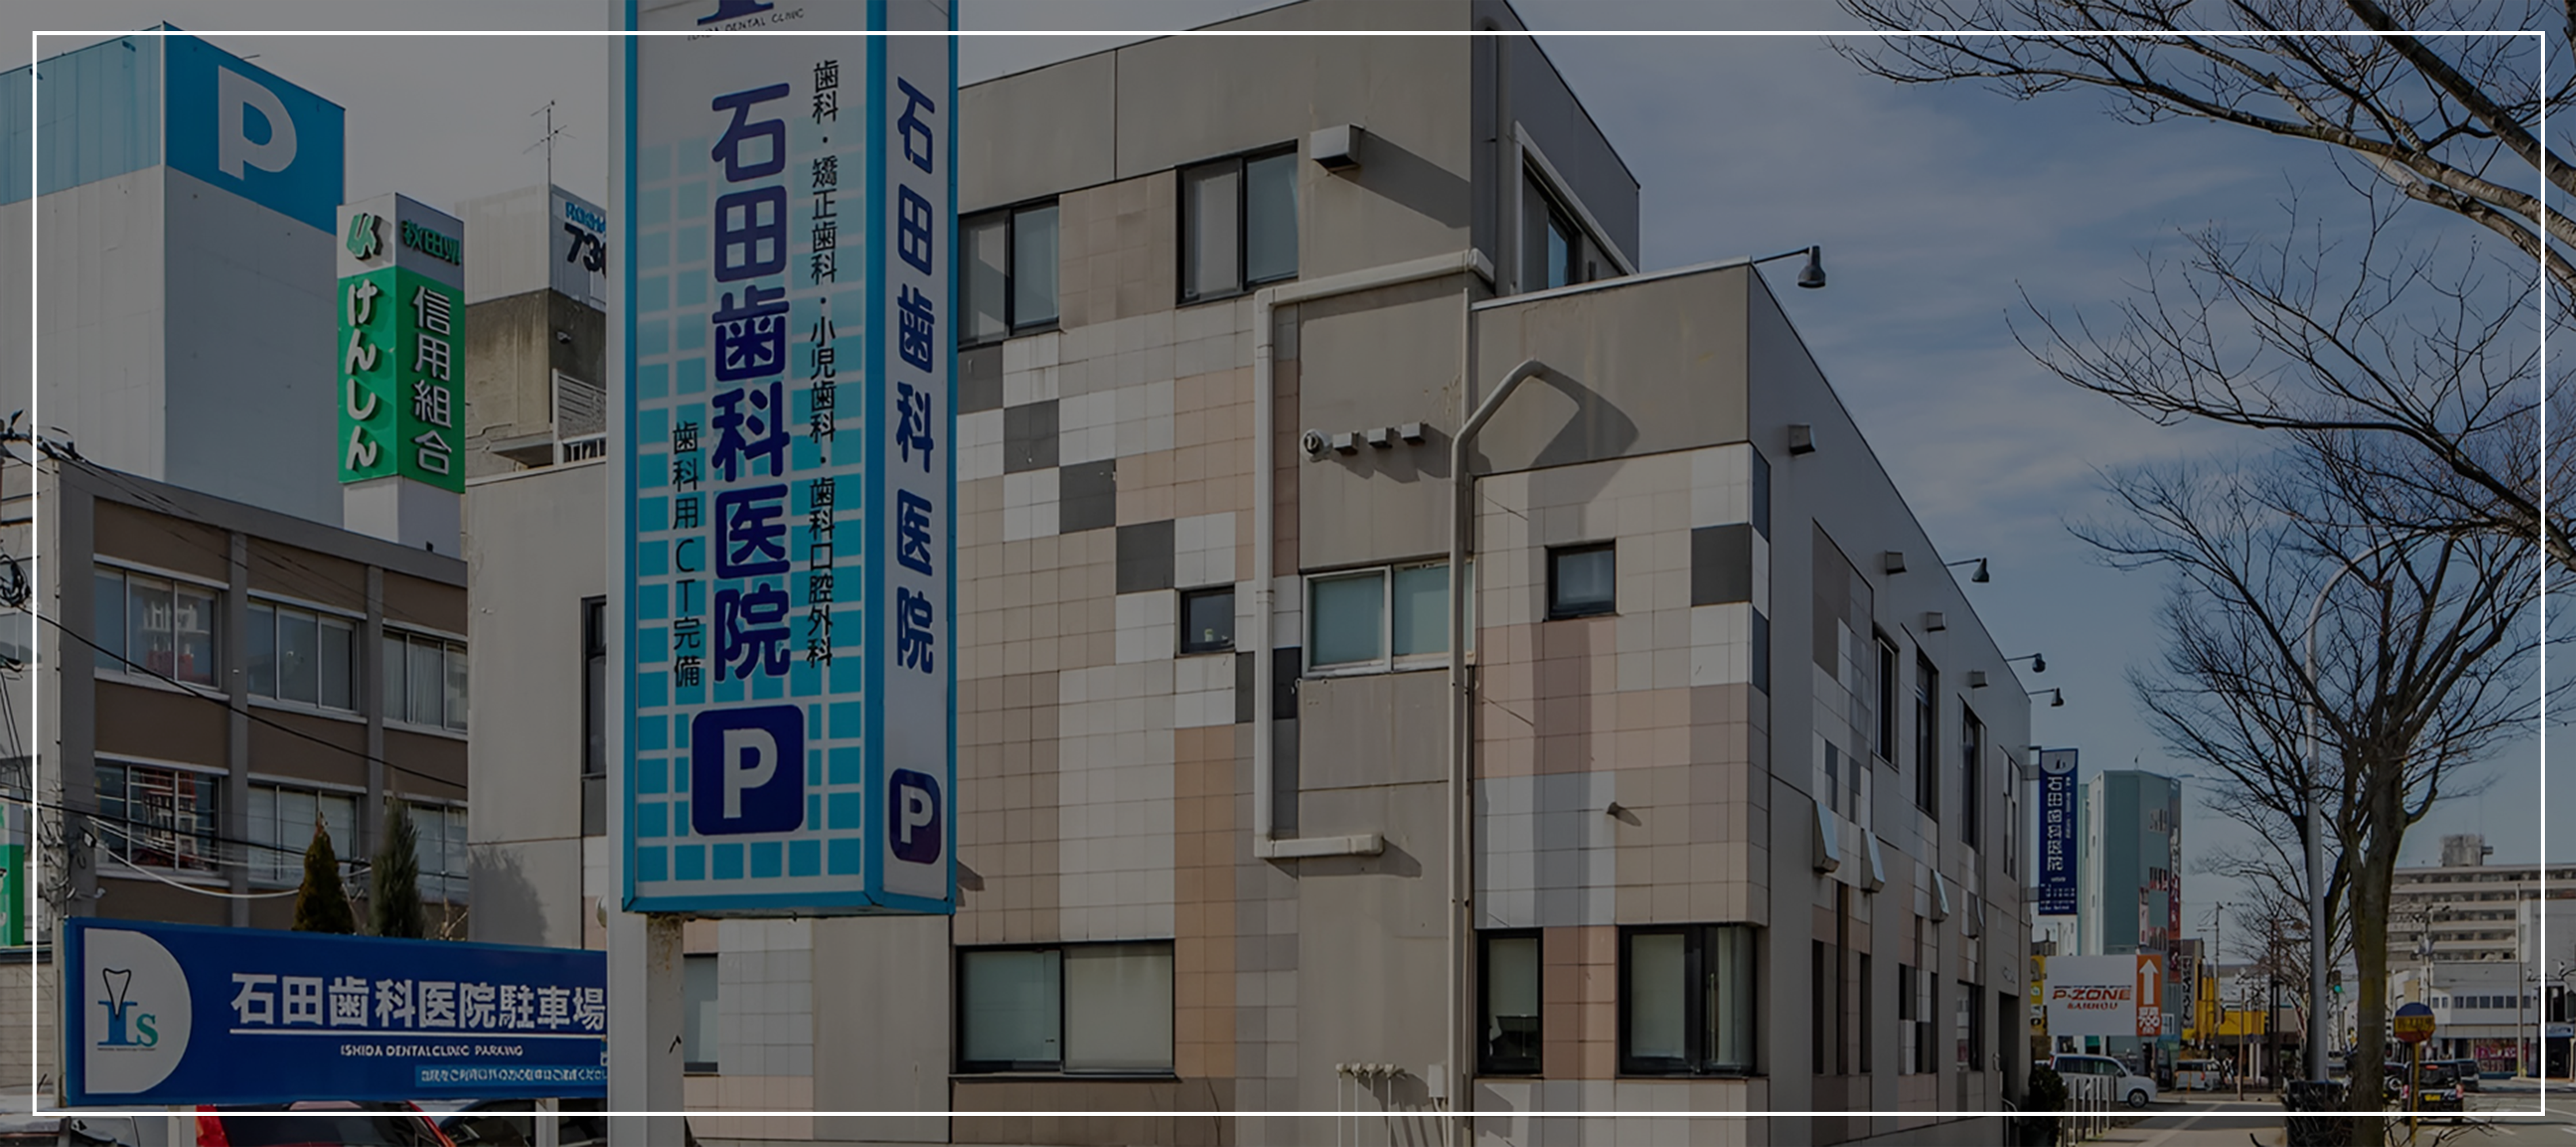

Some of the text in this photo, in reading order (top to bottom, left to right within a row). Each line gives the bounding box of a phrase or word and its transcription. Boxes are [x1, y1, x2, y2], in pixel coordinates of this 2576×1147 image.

[218, 65, 298, 181] P
[564, 222, 606, 278] 73
[344, 279, 380, 473] けんしん
[411, 285, 452, 476] 信用組合
[712, 83, 790, 682] 石田歯科医院
[896, 76, 935, 674] 石田歯科医院
[723, 727, 779, 820] P
[900, 784, 934, 845] P
[230, 972, 606, 1030] 石田歯科医院駐車場
